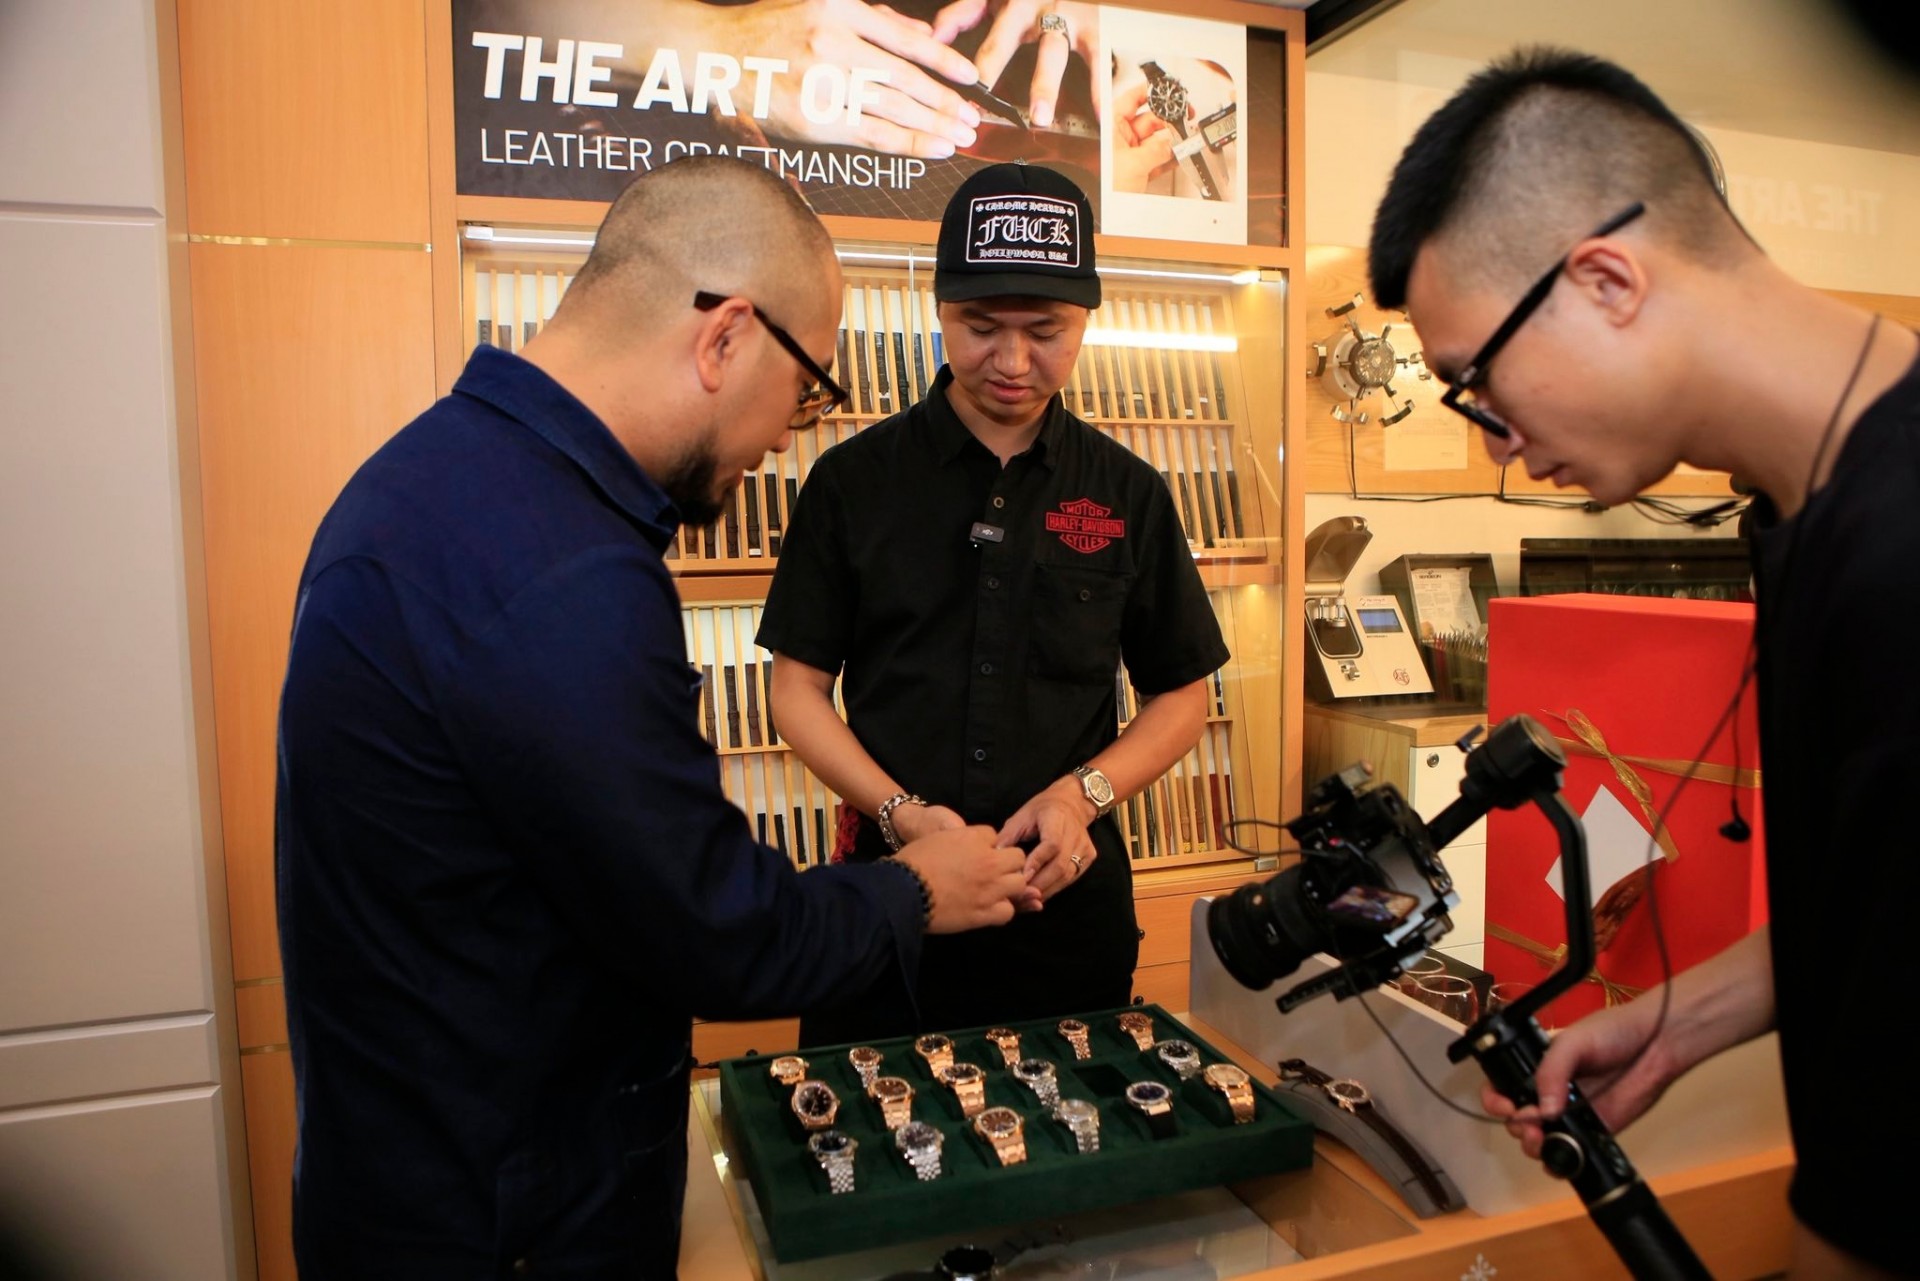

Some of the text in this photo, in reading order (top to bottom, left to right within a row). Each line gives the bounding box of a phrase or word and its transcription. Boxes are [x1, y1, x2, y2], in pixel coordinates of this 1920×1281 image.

[472, 31, 893, 127] THE ART OF
[480, 128, 653, 172] LEATHER
[1066, 503, 1104, 518] MOTOR
[1049, 515, 1121, 534] HARLEY-DAVIDSON
[1066, 533, 1104, 550] CYCLES
